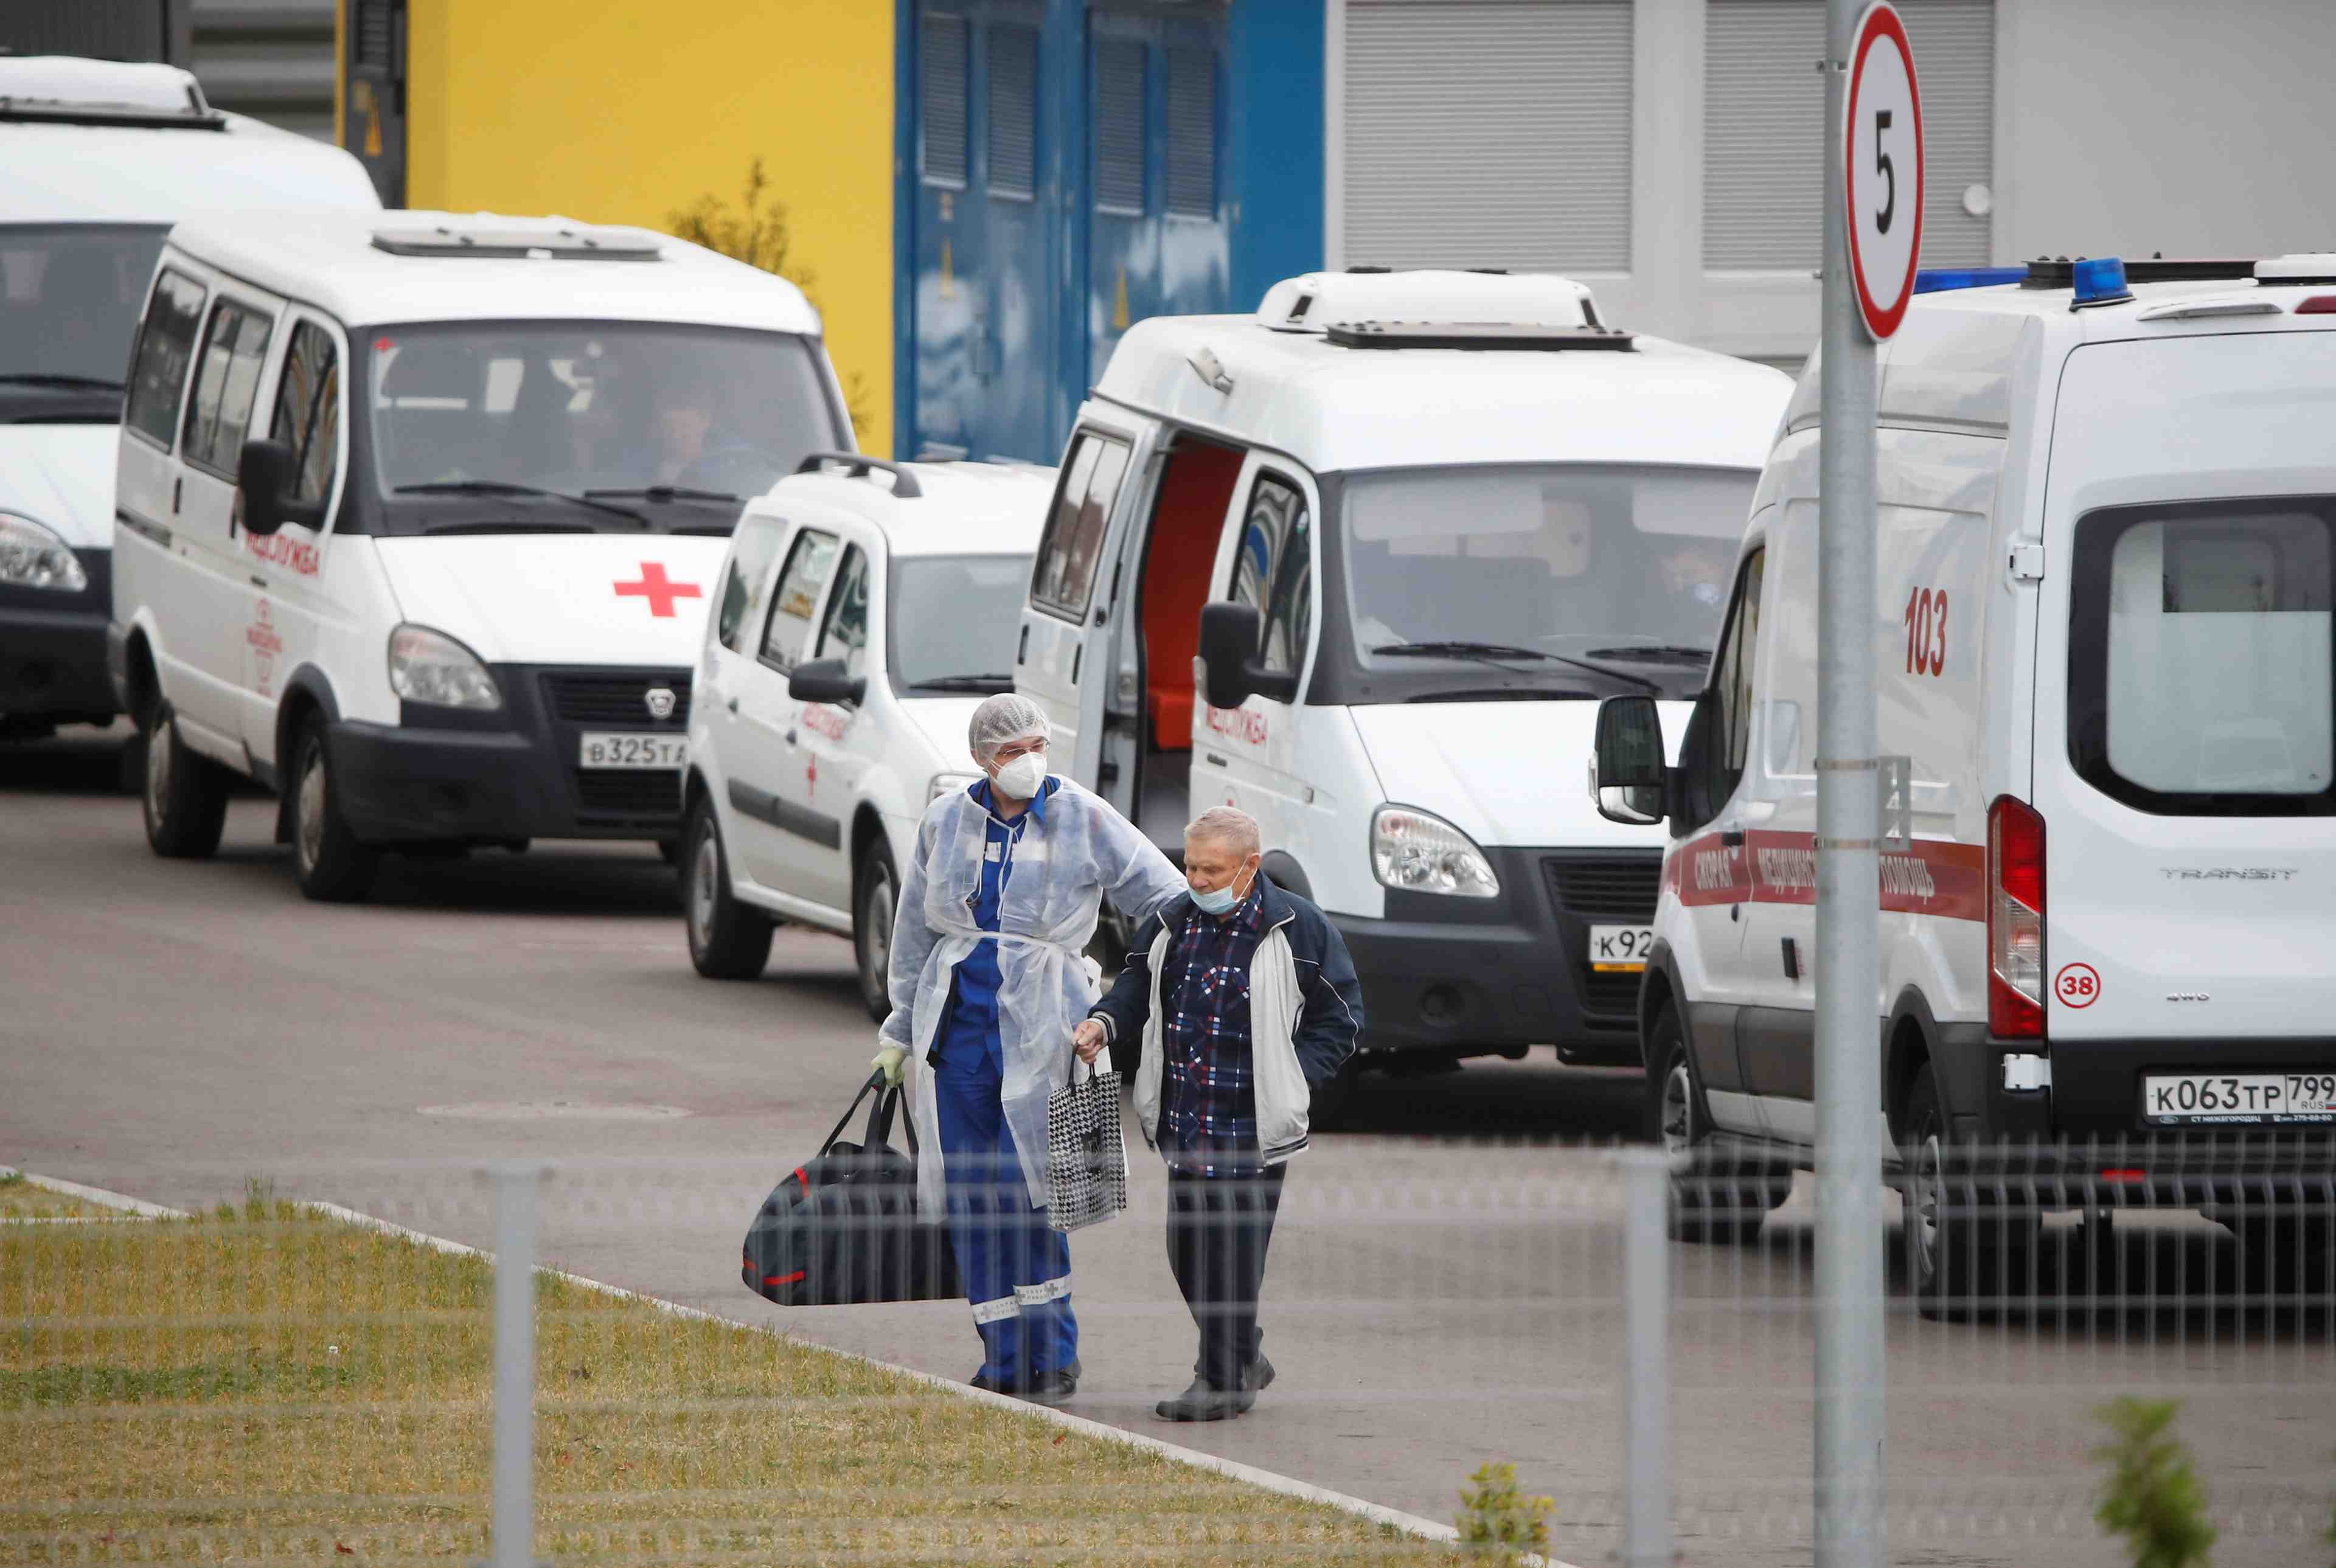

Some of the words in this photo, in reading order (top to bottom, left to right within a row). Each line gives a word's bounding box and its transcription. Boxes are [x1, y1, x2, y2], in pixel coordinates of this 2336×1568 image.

[1876, 110, 1894, 234] 5
[1905, 586, 1947, 676] 103
[2160, 868, 2298, 879] TRANSIT
[1601, 930, 1652, 957] К92
[2062, 976, 2093, 995] 38
[2166, 992, 2209, 1002] 4WD
[2157, 1079, 2281, 1111] К063ТР
[2288, 1077, 2335, 1100] 799
